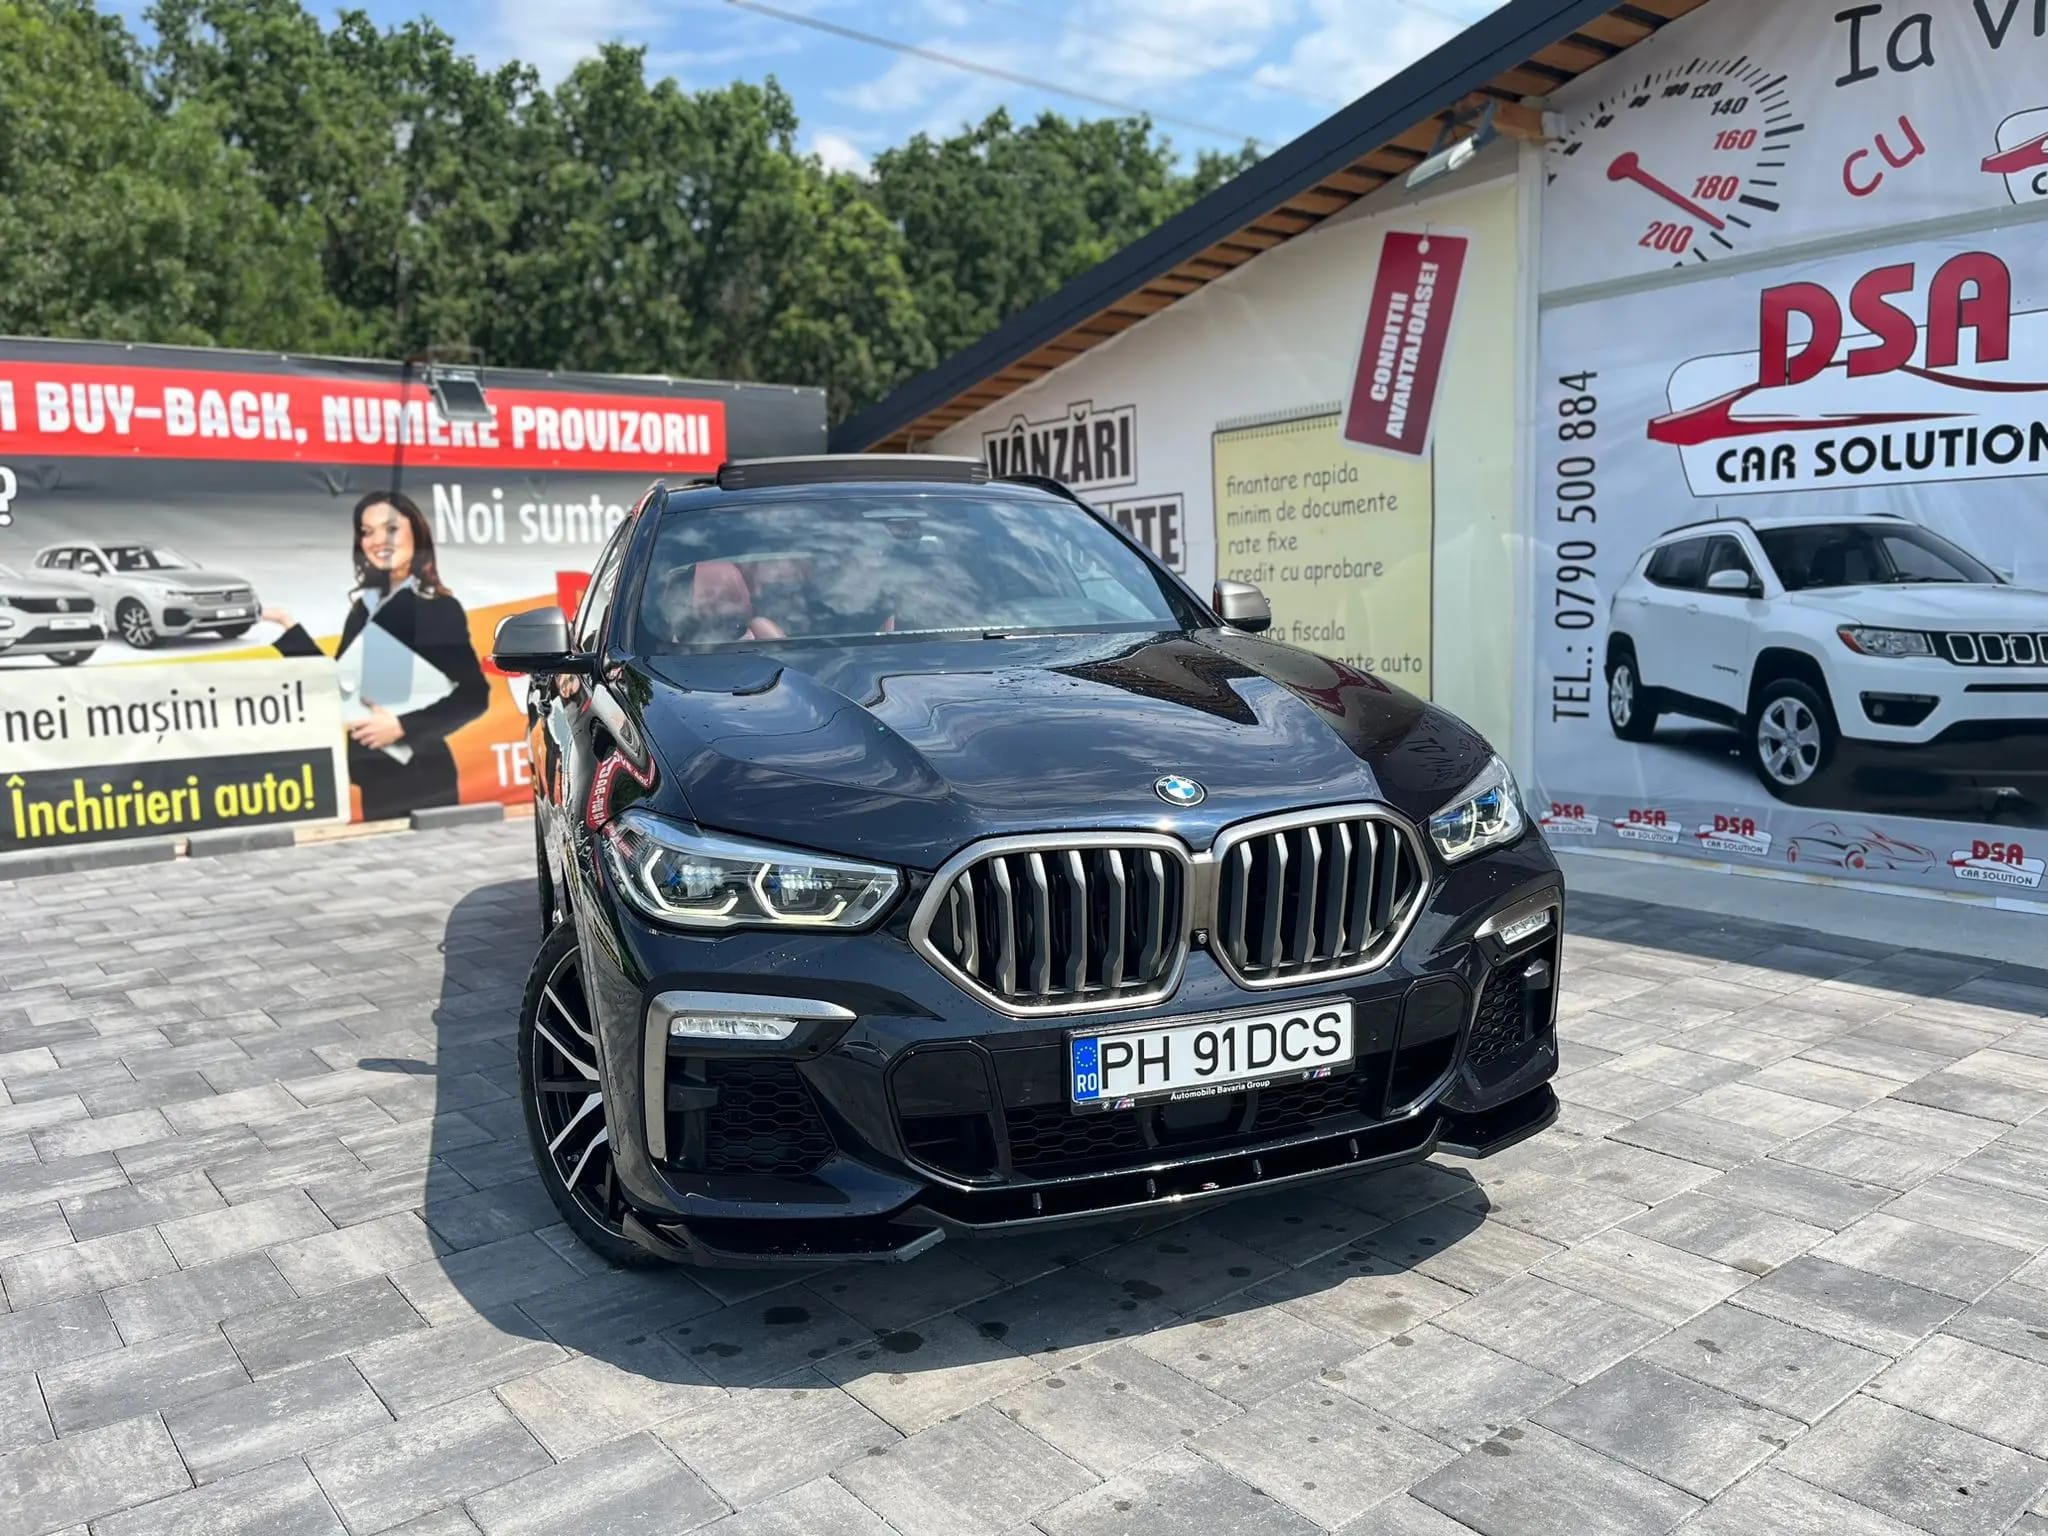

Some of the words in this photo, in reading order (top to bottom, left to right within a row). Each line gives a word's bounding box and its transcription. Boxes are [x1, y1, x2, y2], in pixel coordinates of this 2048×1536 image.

[1834, 4, 1934, 87] Ia
[1691, 82, 1723, 99] 120
[1710, 97, 1749, 116] 140
[1712, 128, 1758, 150] 160
[1843, 115, 1925, 197] cu
[1691, 175, 1740, 201] 180
[1638, 220, 1694, 255] 200
[1759, 251, 2012, 388] DSA
[1371, 291, 1409, 402] CONDITII
[1385, 261, 1440, 440] AVANTAJOASE!
[35, 381, 308, 444] BUY-BACK,
[321, 395, 499, 448] NUMERE
[511, 405, 710, 455] PROVIZORII
[1558, 370, 1598, 441] 884
[988, 410, 1131, 485] VÂNZĂRI
[1716, 444, 1796, 483] CAR
[1814, 421, 2048, 478] SOLUTION
[1226, 474, 1298, 498] finantare
[1304, 462, 1359, 493] rapida
[1556, 456, 1597, 524] 500
[432, 484, 504, 544] Noi
[519, 493, 630, 544] sunte
[1227, 506, 1272, 528] minim
[1277, 501, 1297, 521] de
[1302, 492, 1399, 519] documente
[1229, 537, 1262, 555] rate
[1267, 531, 1298, 551] fixe
[1228, 562, 1275, 583] credit
[1280, 566, 1299, 582] cu
[1304, 558, 1384, 586] aprobare
[1554, 540, 1597, 630] 0790
[1292, 619, 1345, 642] fiscala
[1380, 652, 1423, 673] auto
[1553, 645, 1593, 723] TEL.:
[87, 686, 219, 744] mașini
[235, 680, 305, 727] noi!
[6, 774, 201, 838] Închirieri
[214, 763, 315, 819] auto!
[1551, 801, 1584, 819] DSA
[1628, 809, 1666, 826] DSA
[1714, 814, 1755, 837] DSA
[1723, 842, 1764, 854] SOLUTION
[1972, 840, 2024, 865] DSA
[1961, 868, 1980, 878] CAR
[1982, 870, 2033, 886] SOLUTION
[1101, 1035, 1170, 1089] PH
[1077, 1072, 1097, 1093] RO
[1170, 1087, 1216, 1100] Automobile
[1217, 1083, 1246, 1095] Bavaria
[1247, 1079, 1271, 1090] Group
